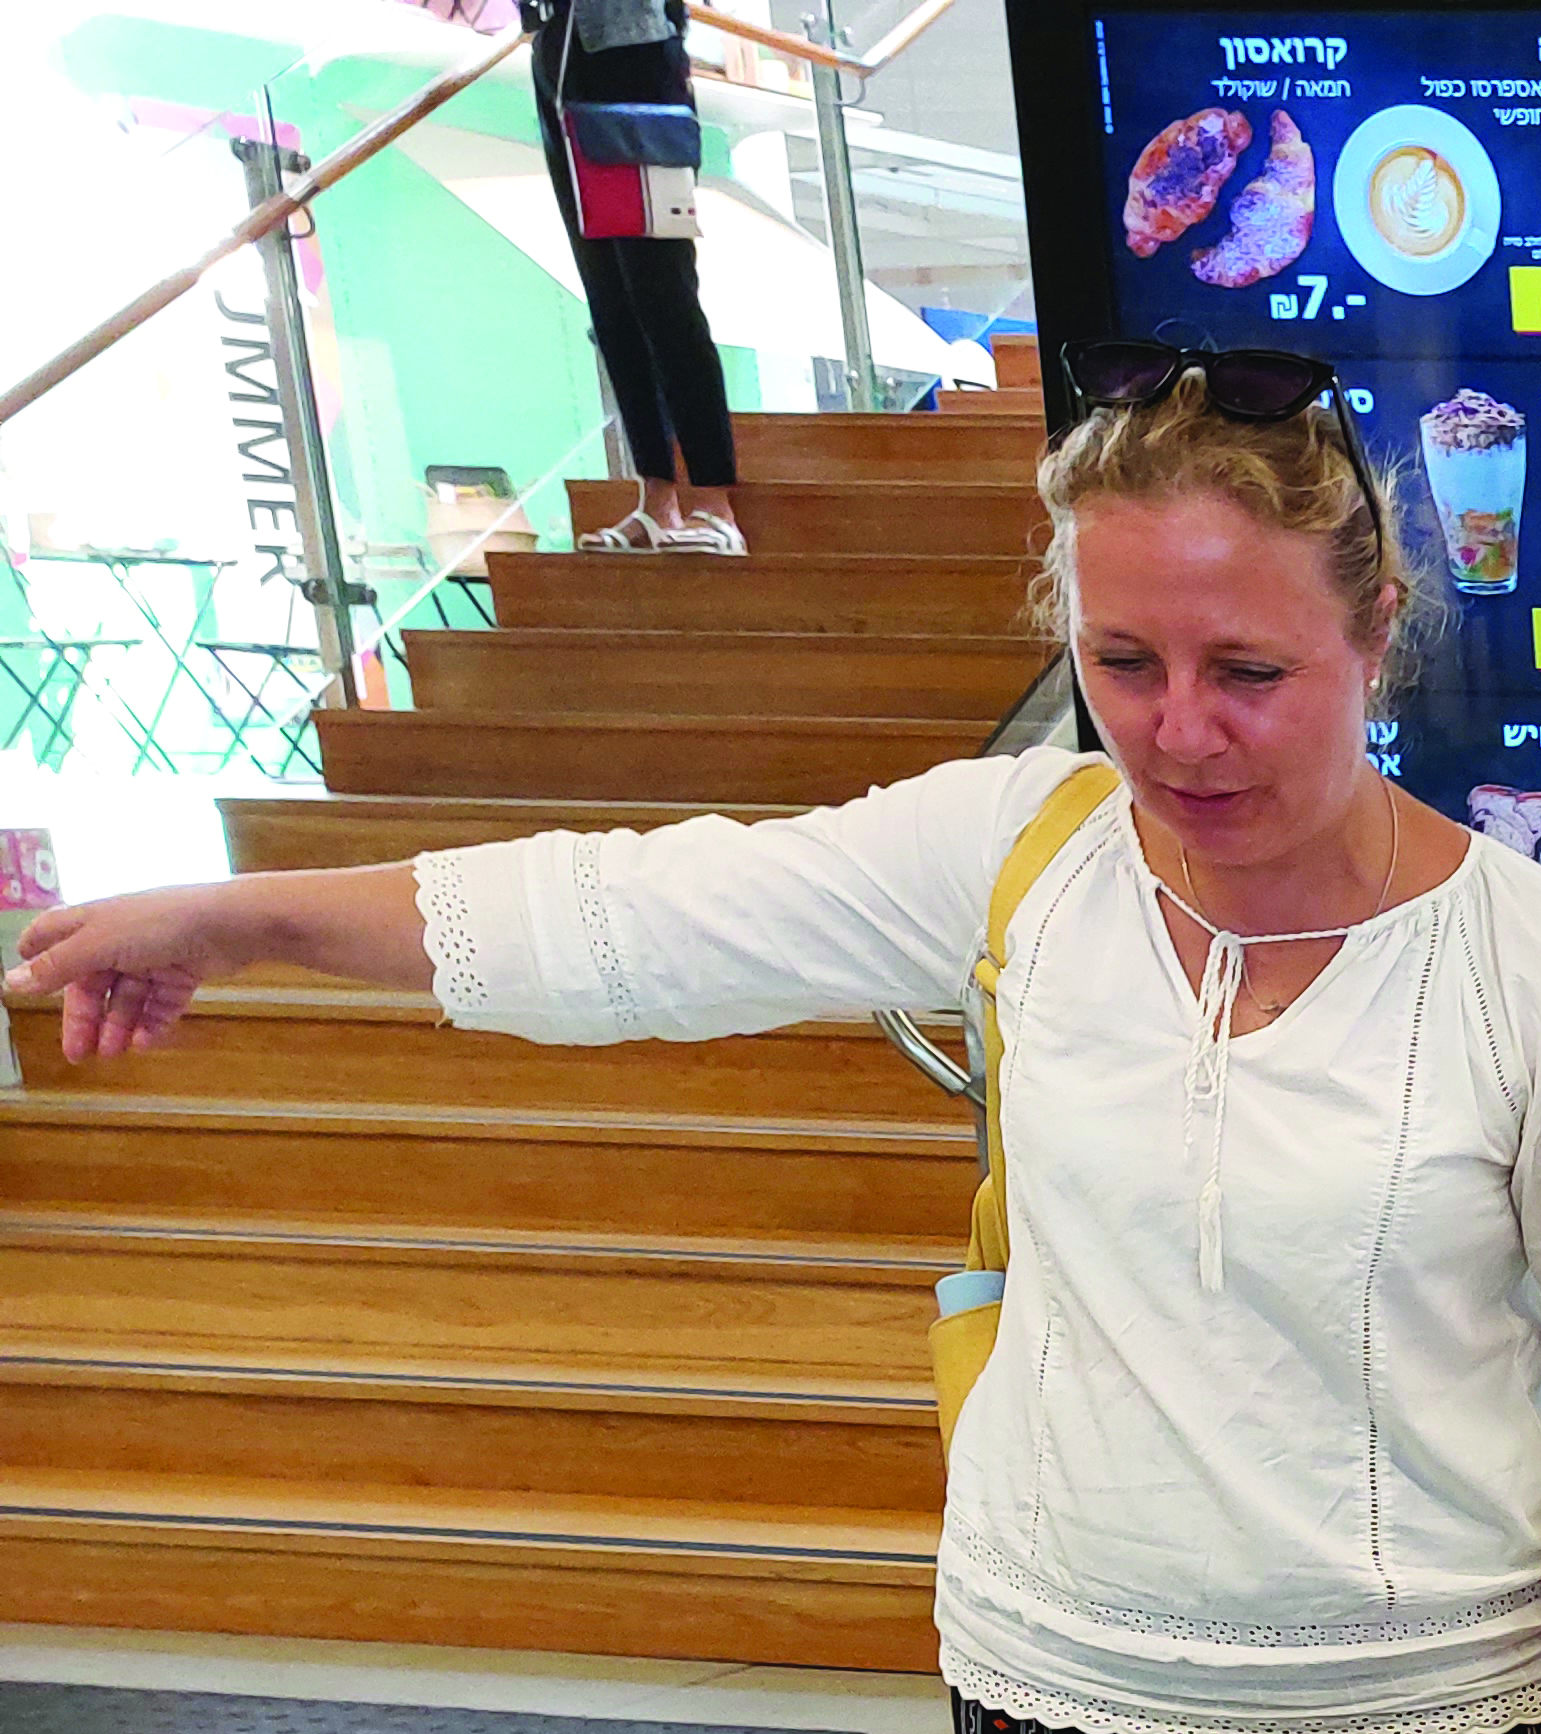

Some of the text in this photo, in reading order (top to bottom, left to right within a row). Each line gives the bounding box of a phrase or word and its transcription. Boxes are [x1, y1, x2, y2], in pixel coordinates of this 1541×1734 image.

[1219, 37, 1348, 70] קרואסון
[1209, 75, 1278, 101] שוקולד
[1294, 79, 1352, 98] חמאה
[1420, 75, 1467, 98] כפול
